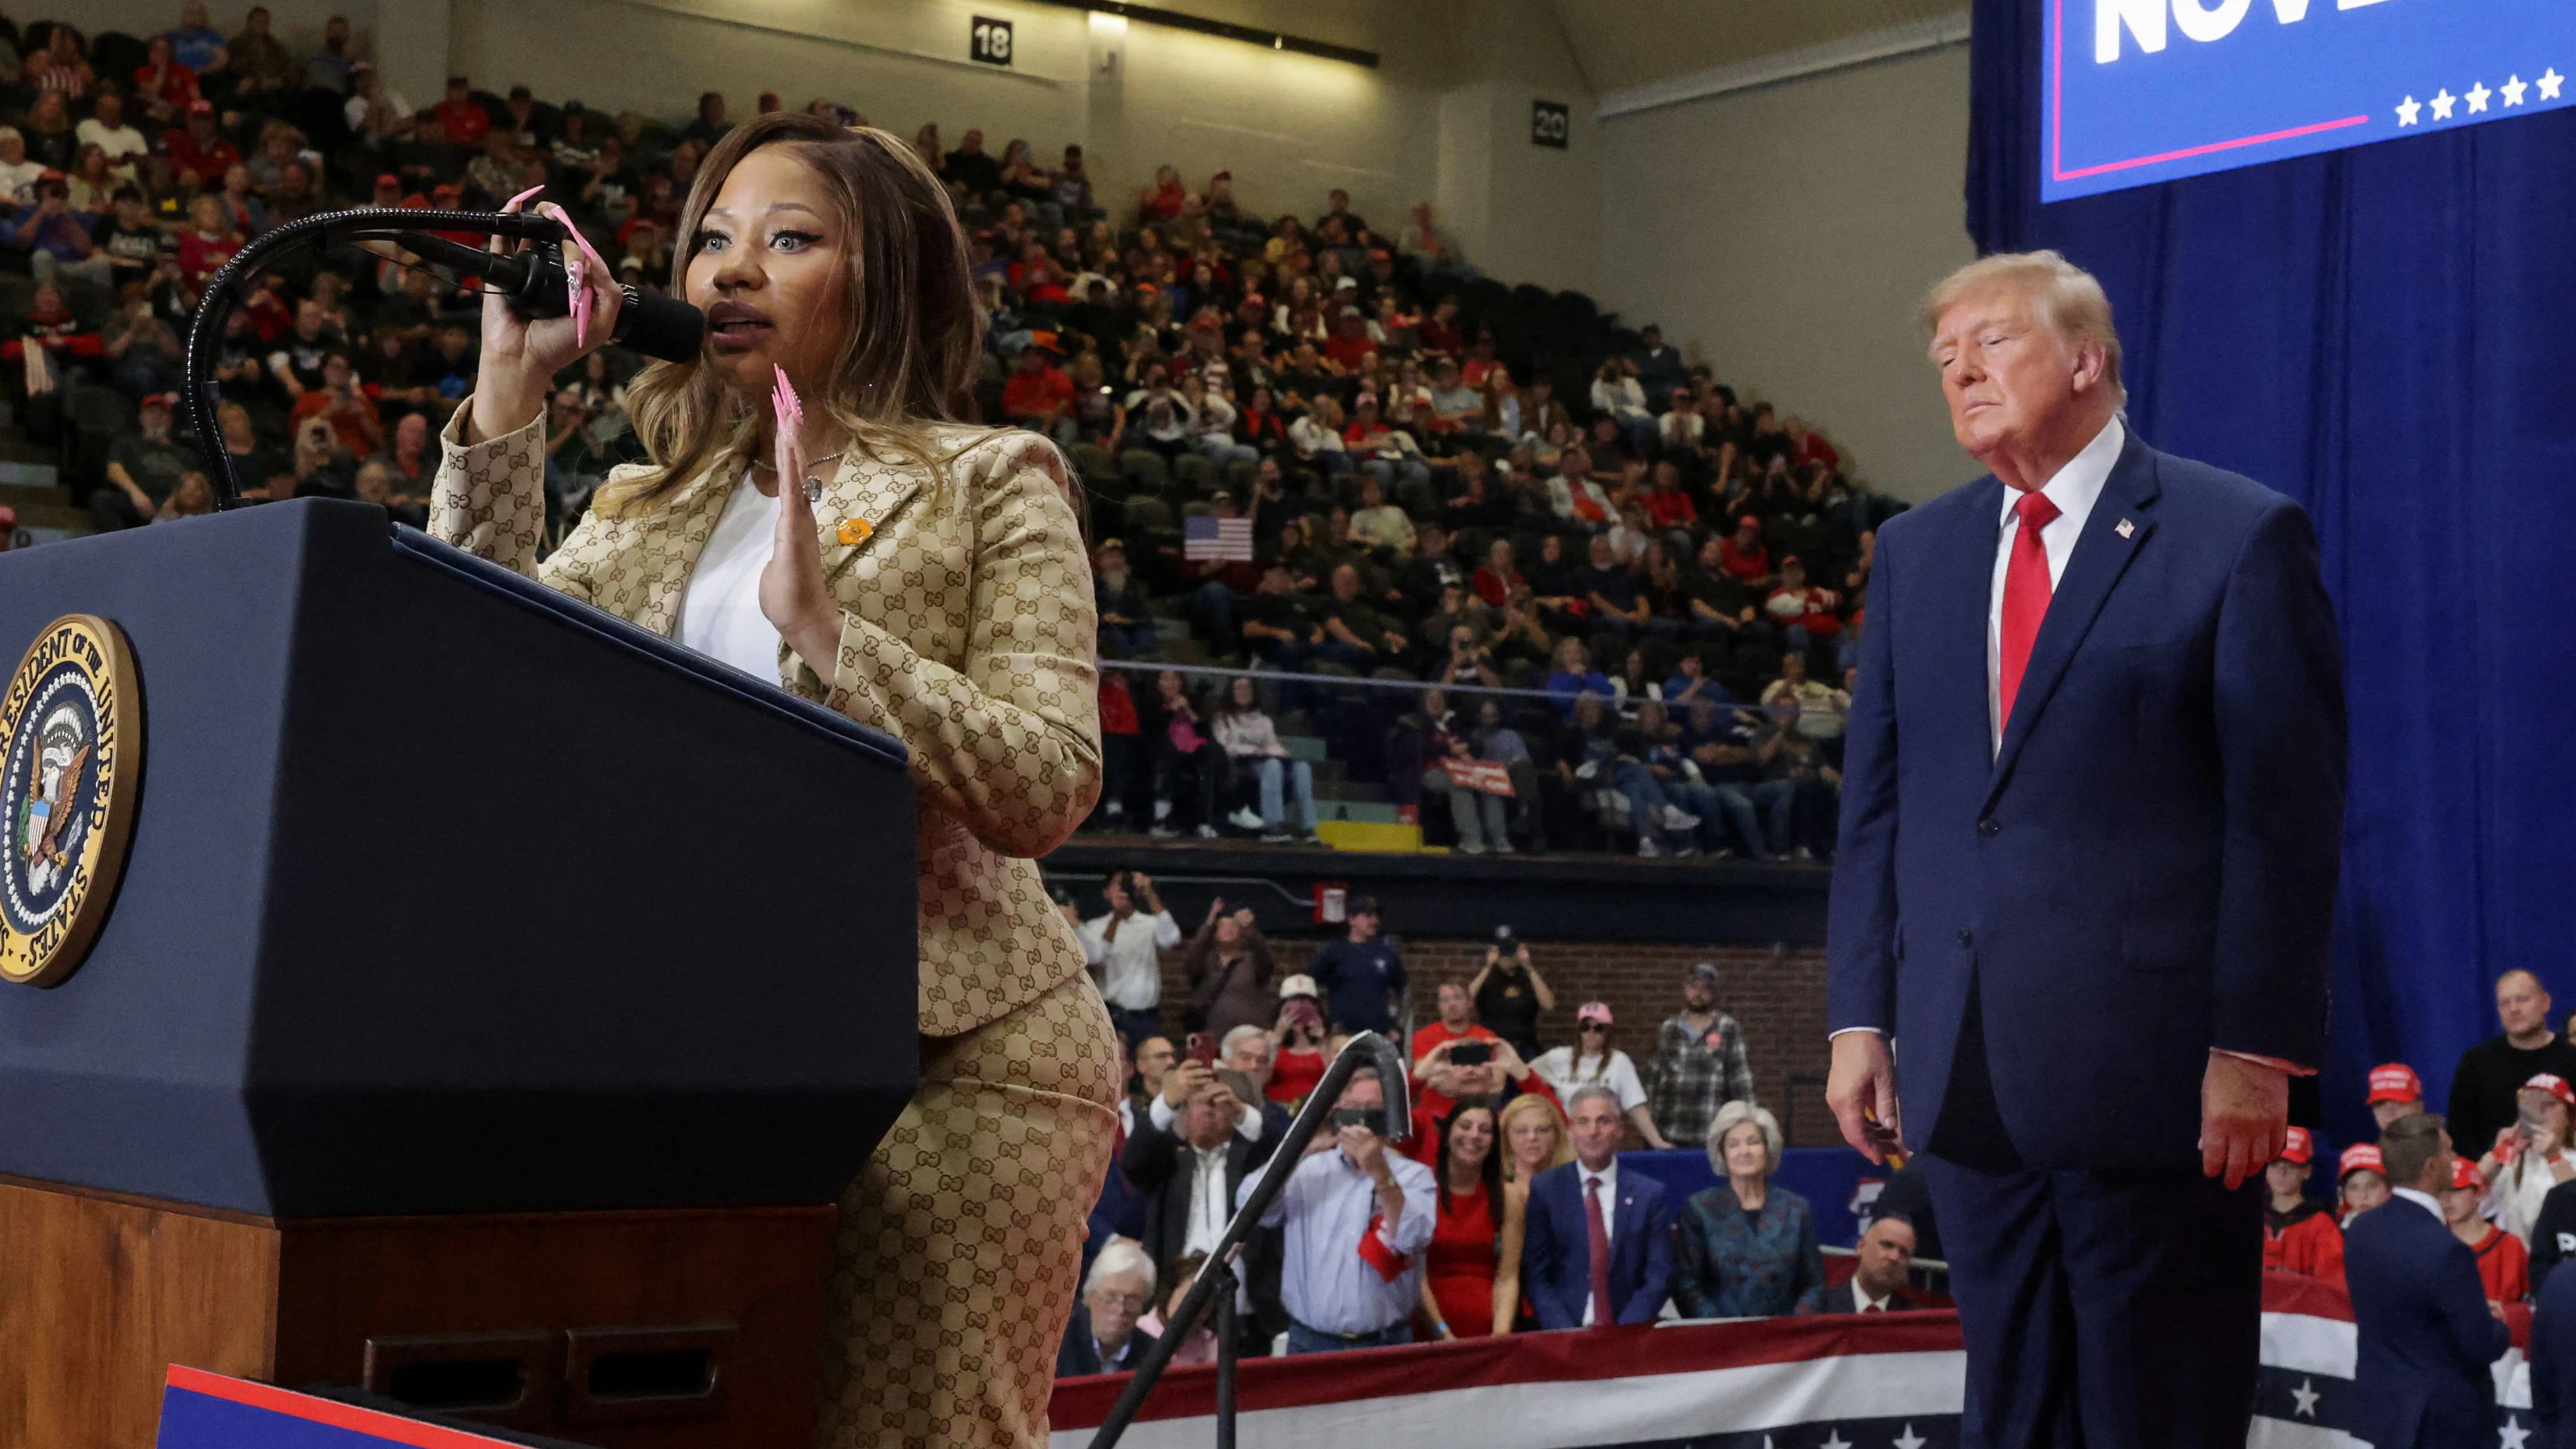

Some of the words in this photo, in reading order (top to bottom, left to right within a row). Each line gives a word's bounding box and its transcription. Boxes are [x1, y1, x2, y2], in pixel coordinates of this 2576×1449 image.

[974, 23, 1009, 58] 18
[1535, 109, 1564, 140] 20
[72, 633, 87, 654] OF
[85, 641, 103, 679] THE
[0, 628, 72, 772] RESIDENT
[91, 676, 114, 830] UNITED
[29, 864, 88, 967] STATES
